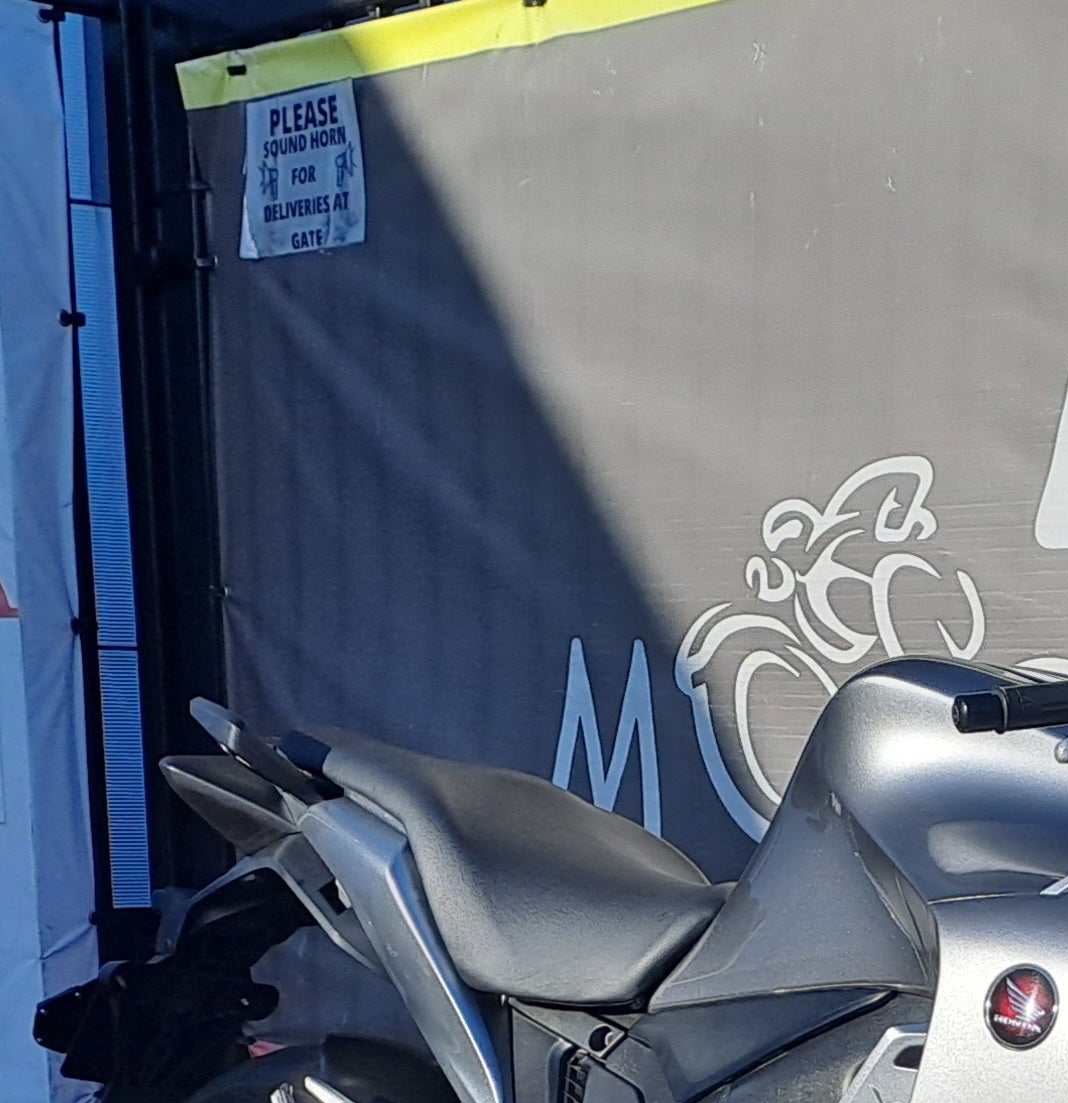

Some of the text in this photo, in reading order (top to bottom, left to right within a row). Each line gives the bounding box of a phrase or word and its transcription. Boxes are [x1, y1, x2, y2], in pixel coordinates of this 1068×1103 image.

[269, 95, 339, 136] PLEASE
[263, 125, 347, 159] SOUND HORN
[291, 165, 316, 185] FOR
[263, 191, 350, 224] DELIVERIES AT
[291, 228, 323, 250] GATE
